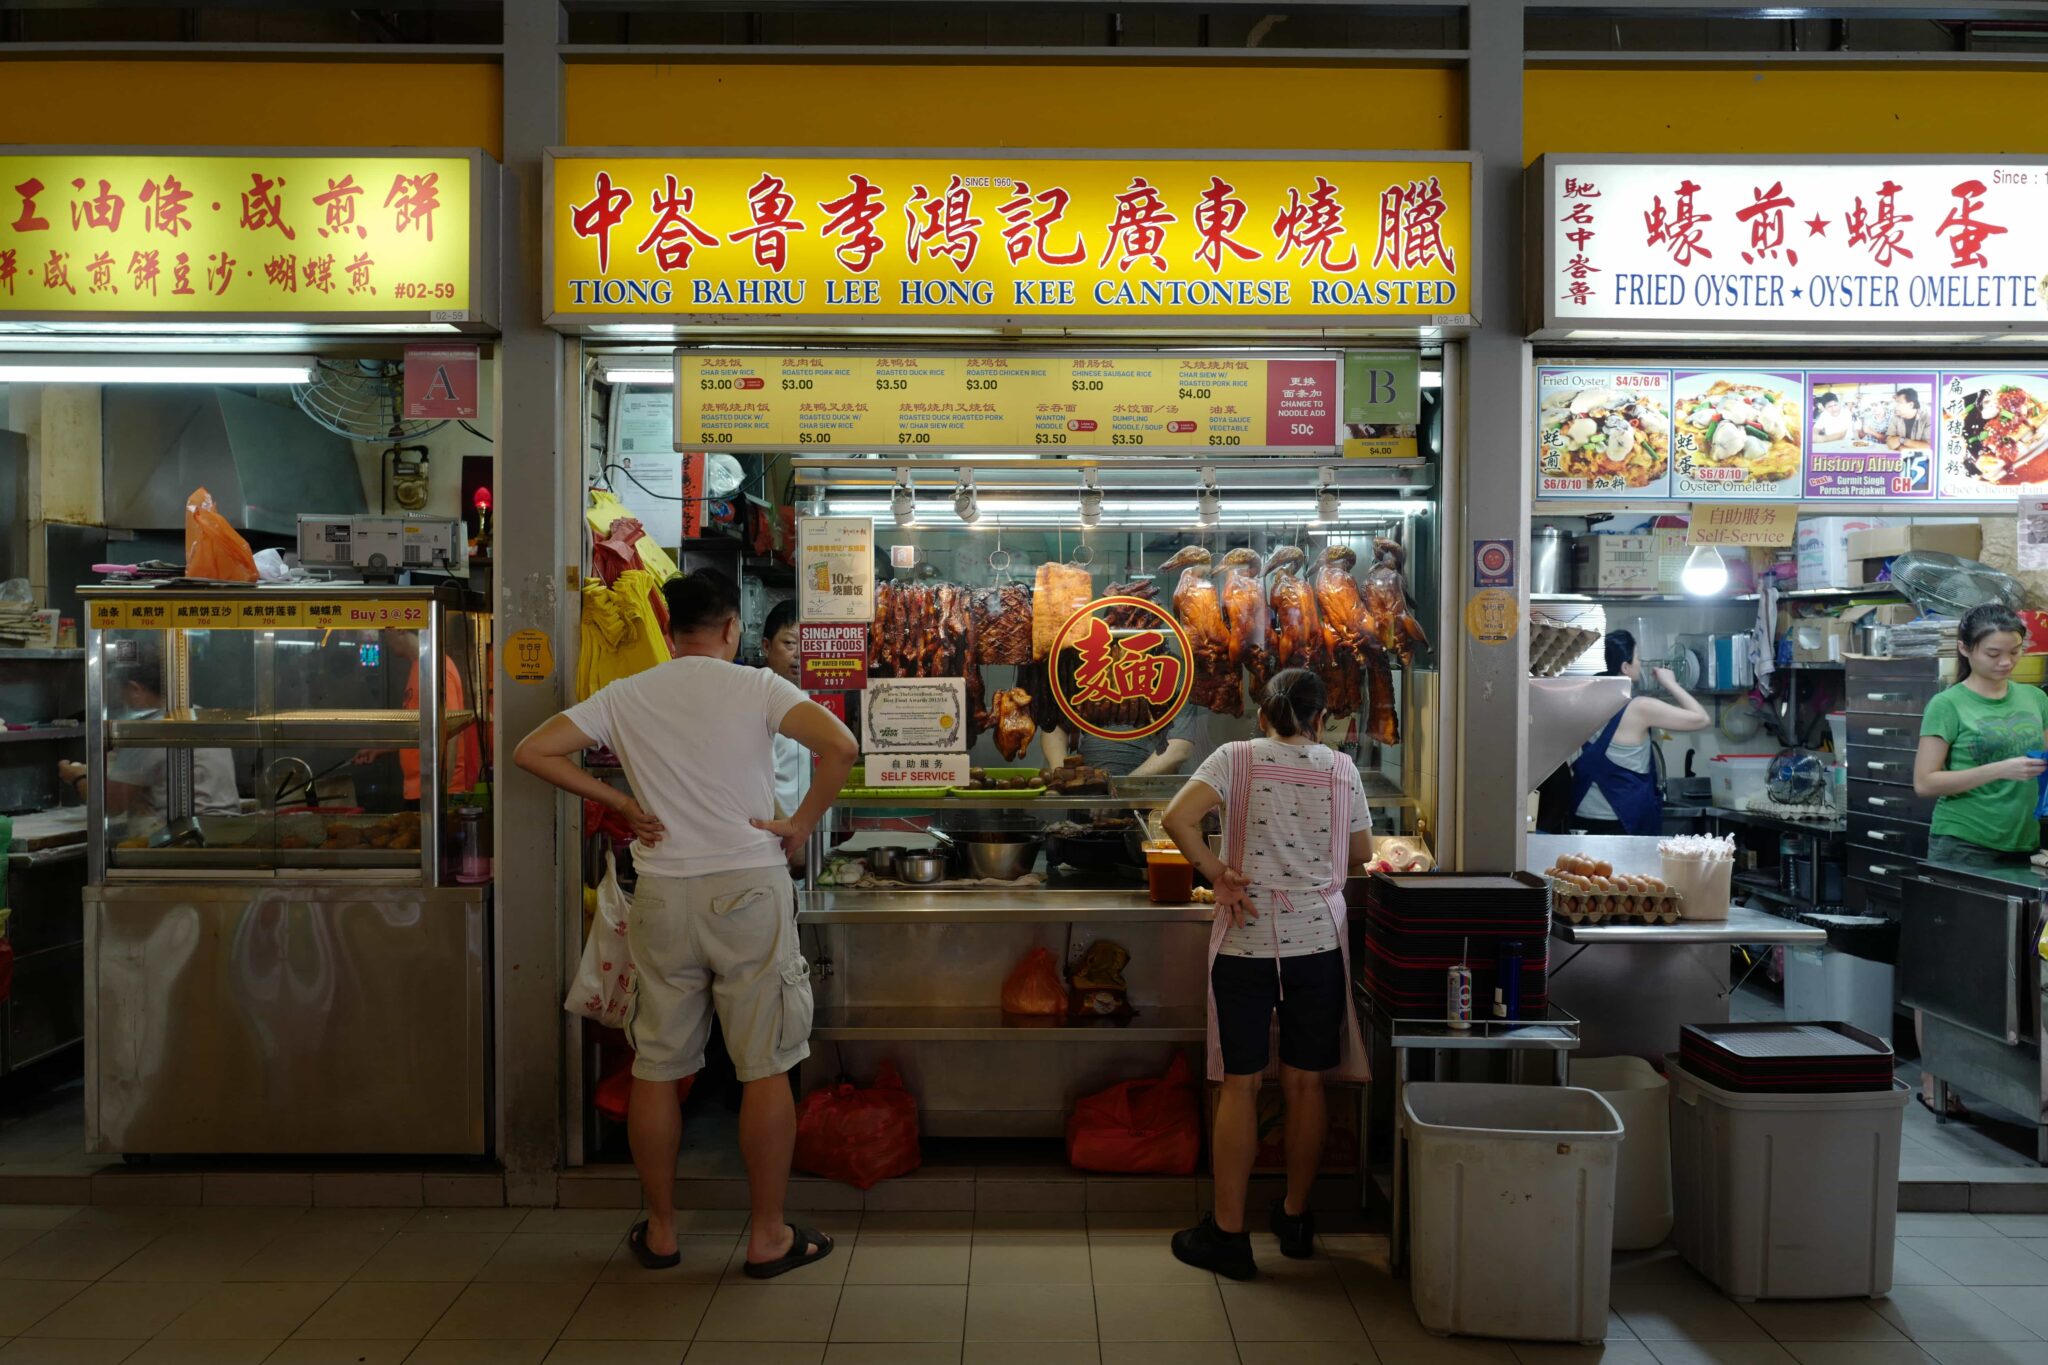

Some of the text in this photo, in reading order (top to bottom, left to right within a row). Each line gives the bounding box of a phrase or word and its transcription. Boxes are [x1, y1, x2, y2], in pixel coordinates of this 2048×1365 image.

[965, 177, 1011, 187] SINCE 1960
[1993, 169, 2027, 184] Since
[1561, 177, 1601, 306] 馳名中峇魯
[395, 283, 455, 299] #02-59
[569, 279, 1457, 305] TIONG BAHRU LEE HONG KEE CANTONESE ROASTED
[1615, 274, 2037, 308] FRIED OYSTER OYSTER OMELETTE
[436, 311, 464, 320] 02-59
[1437, 315, 1465, 325] 02-60
[782, 358, 823, 367] 烧肉饭
[876, 358, 918, 367] 烧鸭饭
[967, 358, 1008, 367] 烧鸡饭
[423, 365, 459, 400] A
[701, 379, 732, 390] $3.00
[782, 379, 813, 390] $3.00
[876, 379, 907, 390] $3.50
[967, 379, 998, 390] $3.00
[1072, 380, 1103, 391] $3.00
[1289, 377, 1316, 386] 更换
[1365, 369, 1397, 404] B
[1543, 375, 1605, 387] Fried Oyster
[1179, 388, 1211, 400] $4.00
[701, 403, 770, 412] 烧鸭烧肉饭
[1036, 404, 1077, 413] 云吞面
[1210, 405, 1237, 414] 油菜
[1291, 424, 1314, 436] 50¢
[701, 433, 732, 444] $5.00
[799, 433, 830, 444] $5.00
[898, 433, 930, 444] $7.00
[1035, 433, 1067, 444] $3.50
[1112, 434, 1144, 445] $3.50
[1209, 435, 1240, 446] $3.00
[1370, 447, 1392, 455] $4.00
[1812, 456, 1904, 473] History Alive
[1680, 480, 1777, 493] Oyster Omelette
[1837, 476, 1885, 486] Gurmit Singh
[1892, 478, 1911, 492] CH
[1820, 486, 1850, 495] Pornsak
[1710, 507, 1776, 525] 自助服务
[1696, 528, 1785, 543] Self-Service
[98, 606, 119, 617] 油条
[351, 609, 375, 622] Buy
[380, 608, 388, 619] 3
[405, 608, 421, 620] $2
[802, 627, 864, 639] SINGAPORE
[804, 640, 862, 651] BEST FOODS
[1070, 616, 1181, 706] 麵
[892, 759, 943, 768] 自助服务
[881, 771, 956, 782] SELF SERVICE
